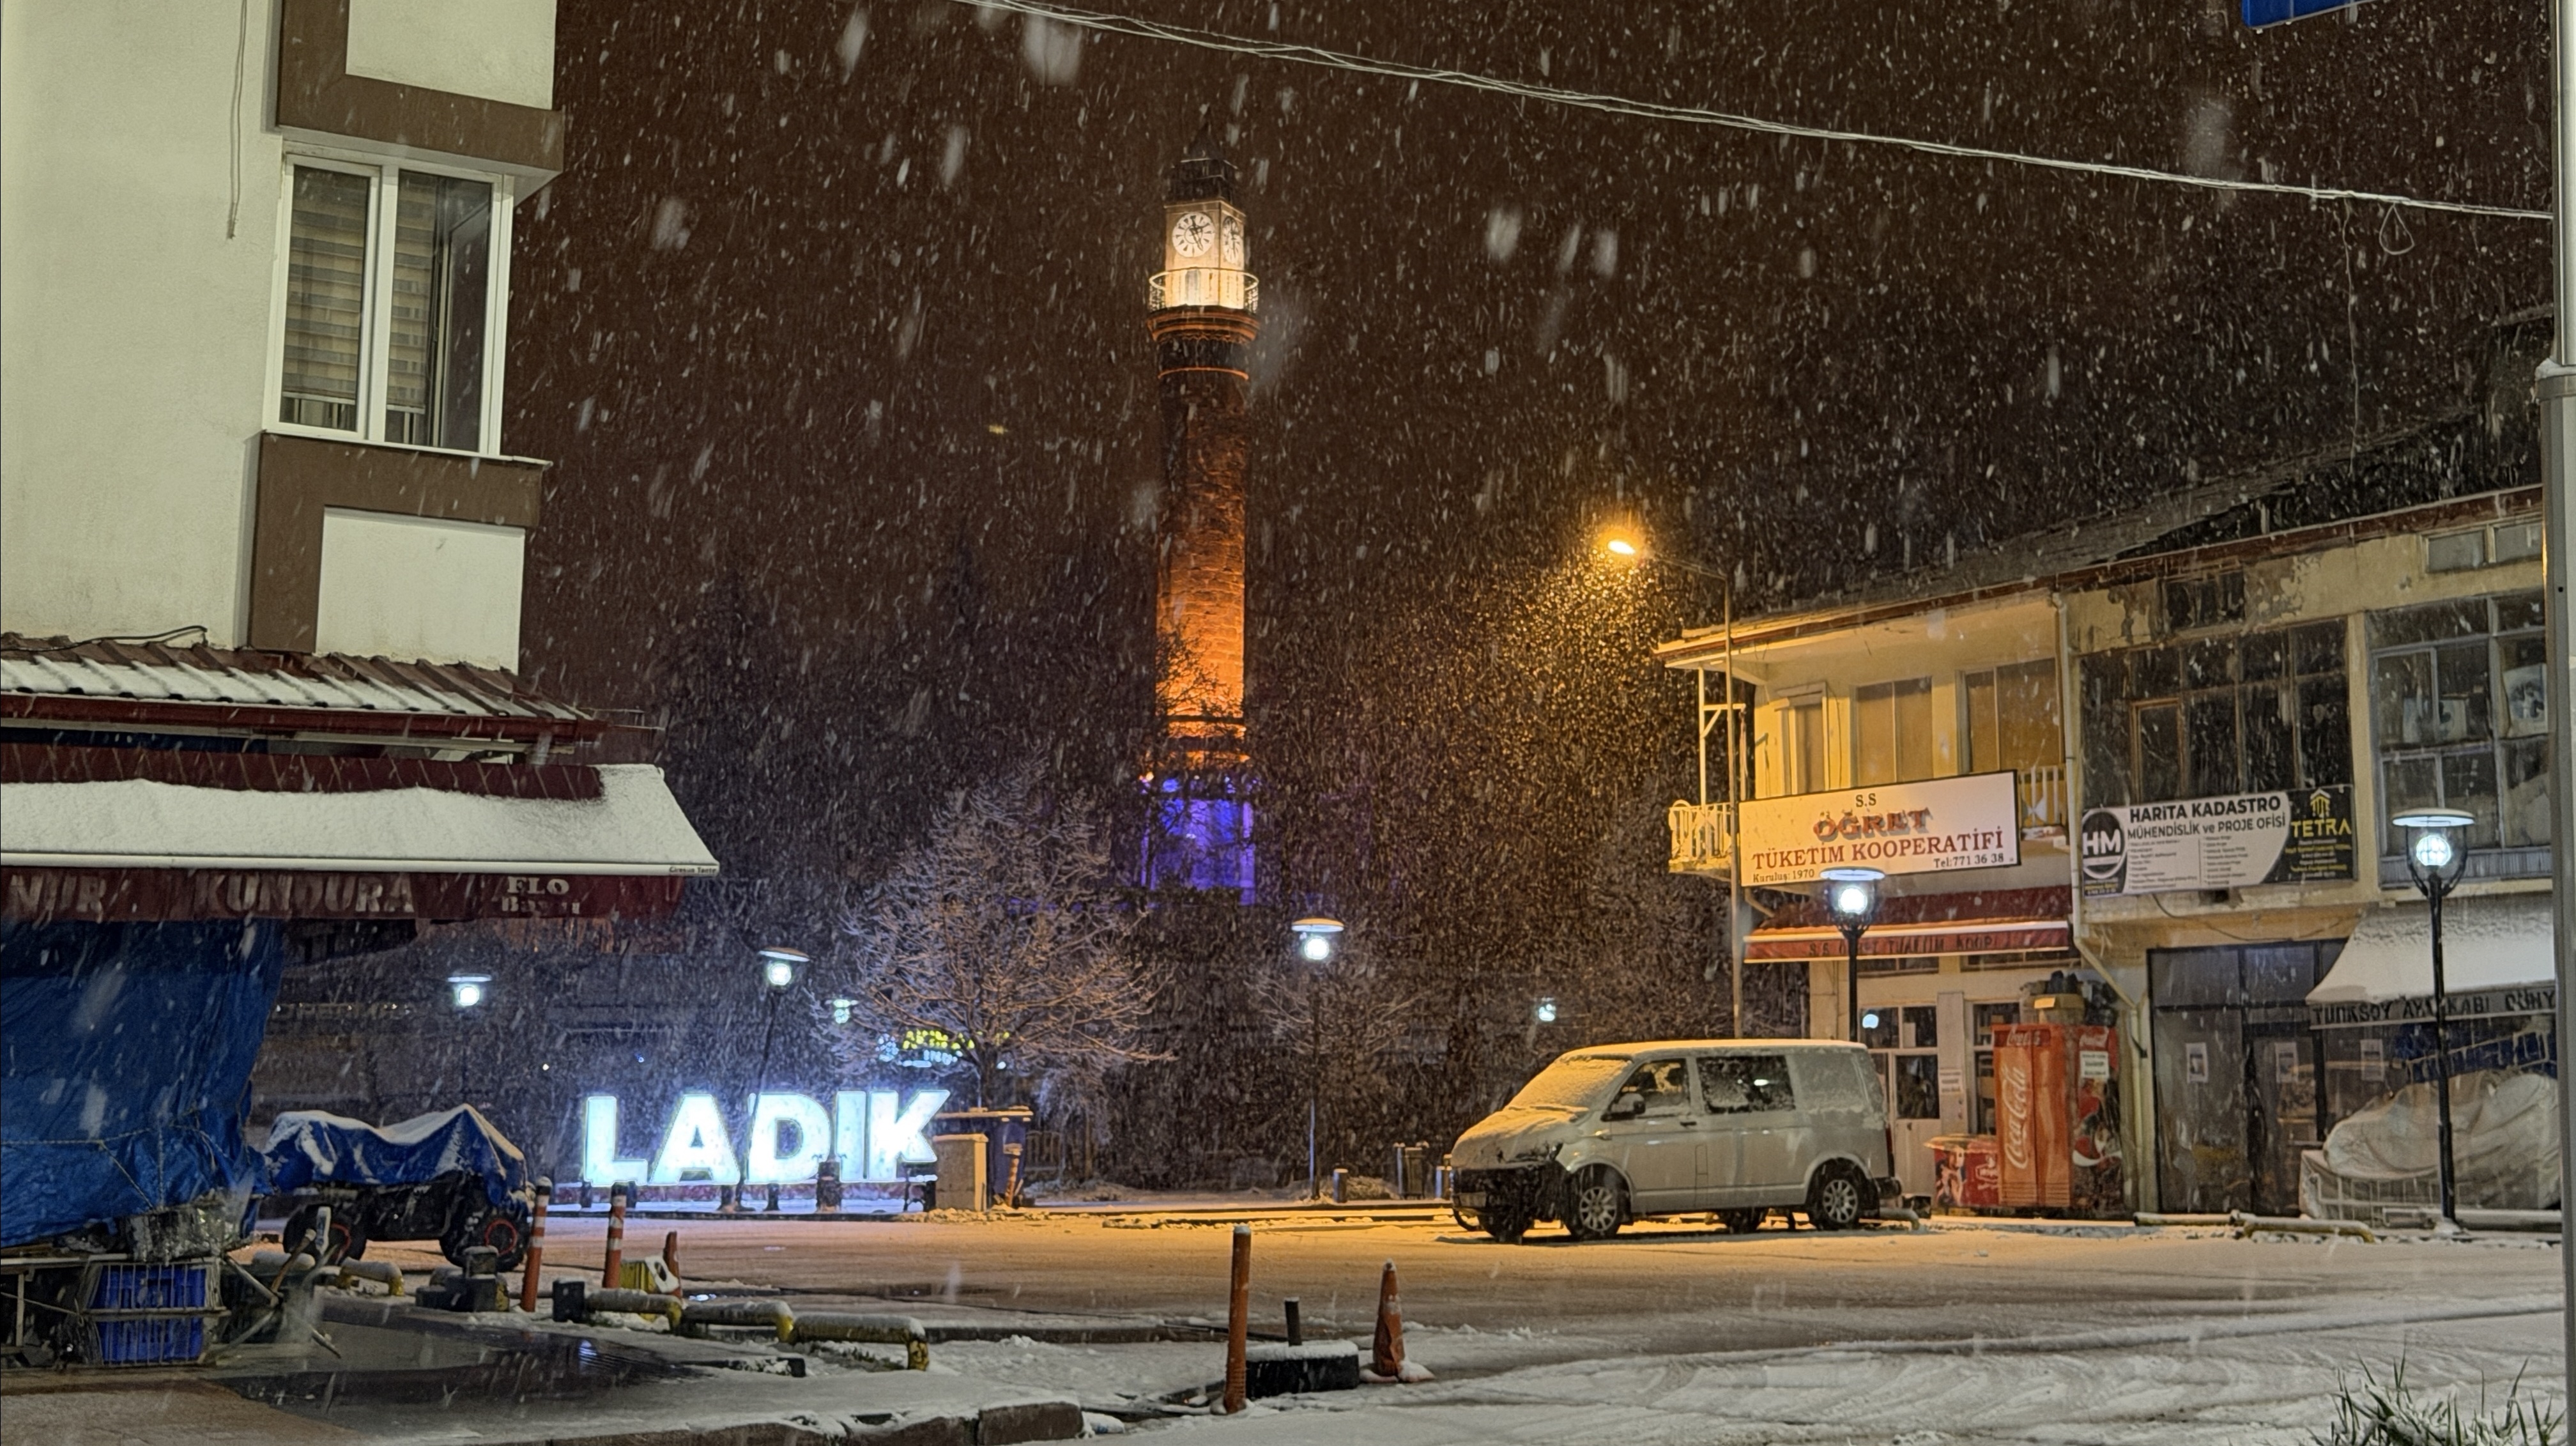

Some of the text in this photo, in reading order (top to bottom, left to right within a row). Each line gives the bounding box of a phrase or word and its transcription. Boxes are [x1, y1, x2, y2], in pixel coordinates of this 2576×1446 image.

[2191, 796, 2281, 817] KADASTRO
[1813, 807, 1932, 841] ÖĞRET
[2128, 811, 2286, 840] MÜHENDİSLİK ve PROJE OFİSİ
[2291, 819, 2352, 838] TETRA
[1752, 826, 2004, 870] TÜKETİM KOOPERATİFİ
[2082, 829, 2121, 856] HM
[507, 876, 570, 895] FLO
[1792, 869, 1815, 879] 1970
[194, 873, 415, 913] KUNDURA
